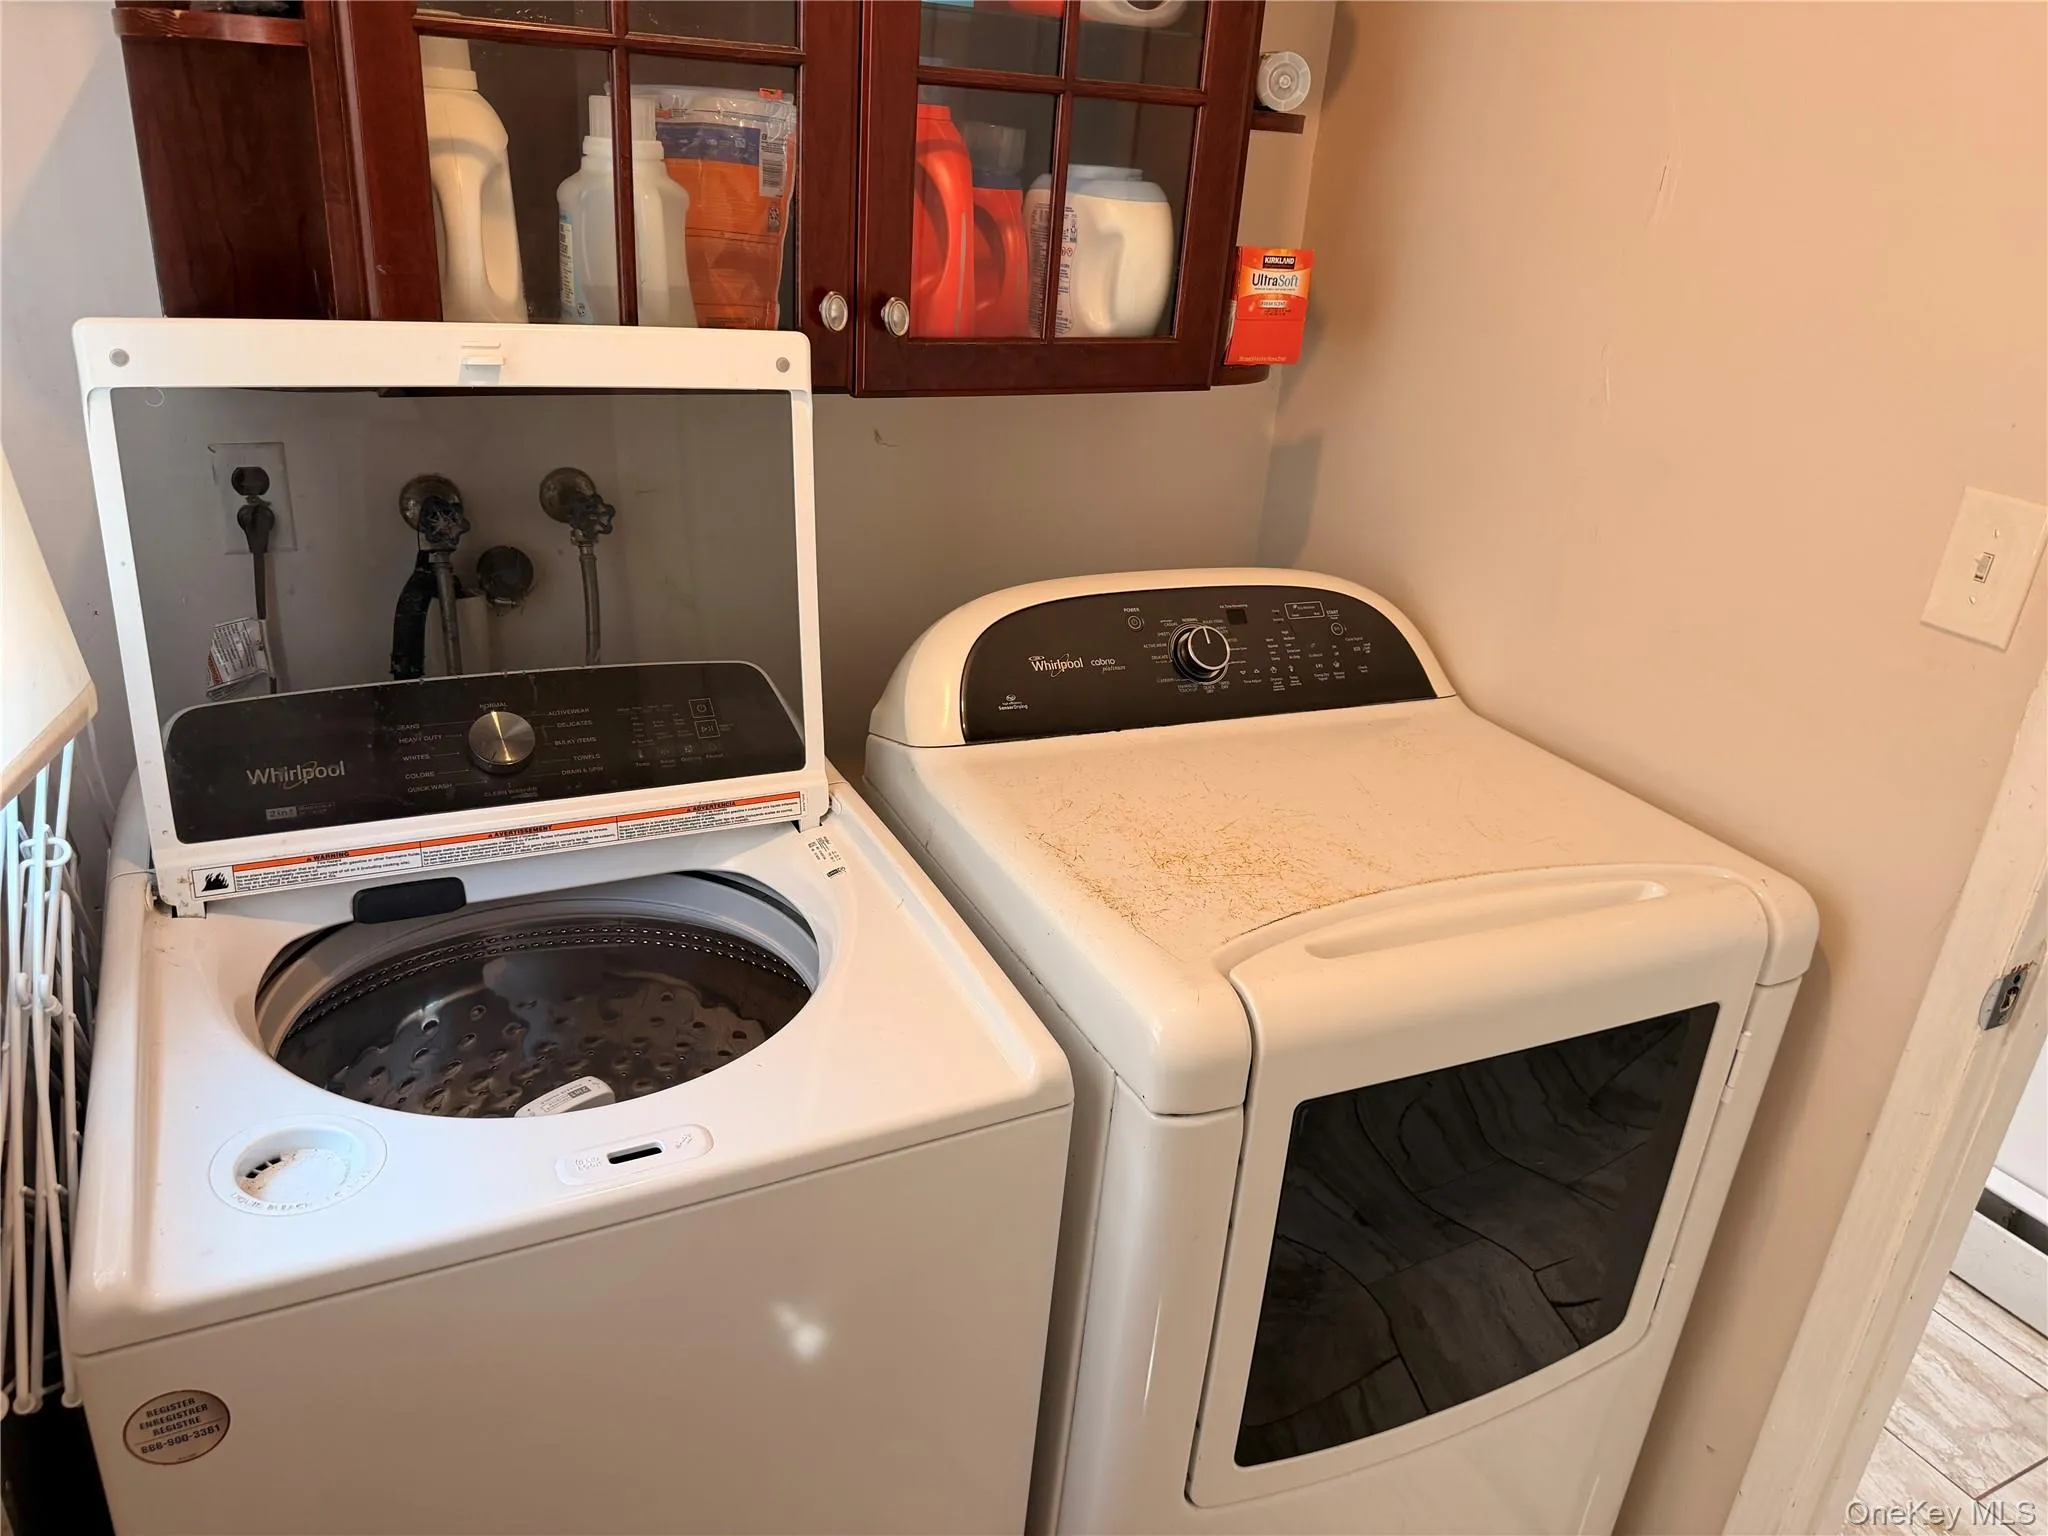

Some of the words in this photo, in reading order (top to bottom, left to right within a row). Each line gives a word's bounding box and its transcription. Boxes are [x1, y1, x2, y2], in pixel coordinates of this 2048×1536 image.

[1264, 256, 1295, 265] KIRKLAND
[1252, 273, 1299, 288] UltraSoft
[1031, 656, 1084, 673] Whirlpool
[1090, 658, 1116, 667] cabrio
[423, 734, 443, 742] DUTY
[403, 753, 431, 762] WHITES
[246, 760, 345, 786] Whirlpool
[405, 771, 436, 780] COLORS
[313, 851, 350, 862] WARNING
[146, 1397, 196, 1418] REGISTER
[139, 1403, 209, 1430] ENREGISTRER
[153, 1415, 202, 1436] REGISTRE
[140, 1423, 221, 1454] 888-900-3381
